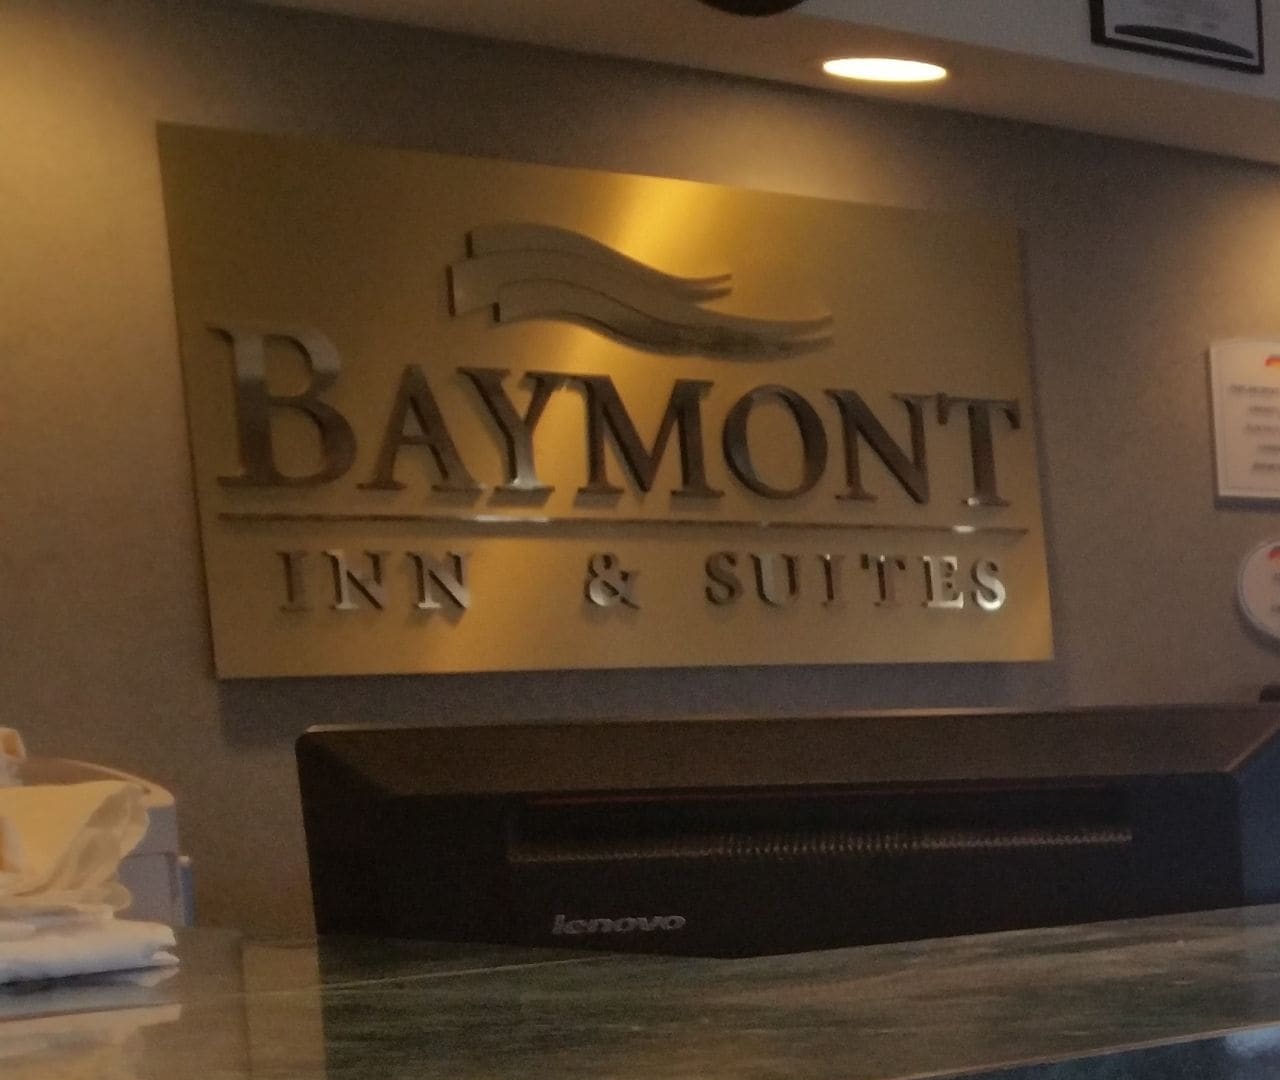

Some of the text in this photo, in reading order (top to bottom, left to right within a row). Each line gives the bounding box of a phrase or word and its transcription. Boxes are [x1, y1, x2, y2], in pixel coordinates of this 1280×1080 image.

[206, 327, 1022, 508] BAYMONT
[276, 550, 1008, 612] INN & SUITES
[552, 913, 687, 935] lenovo
